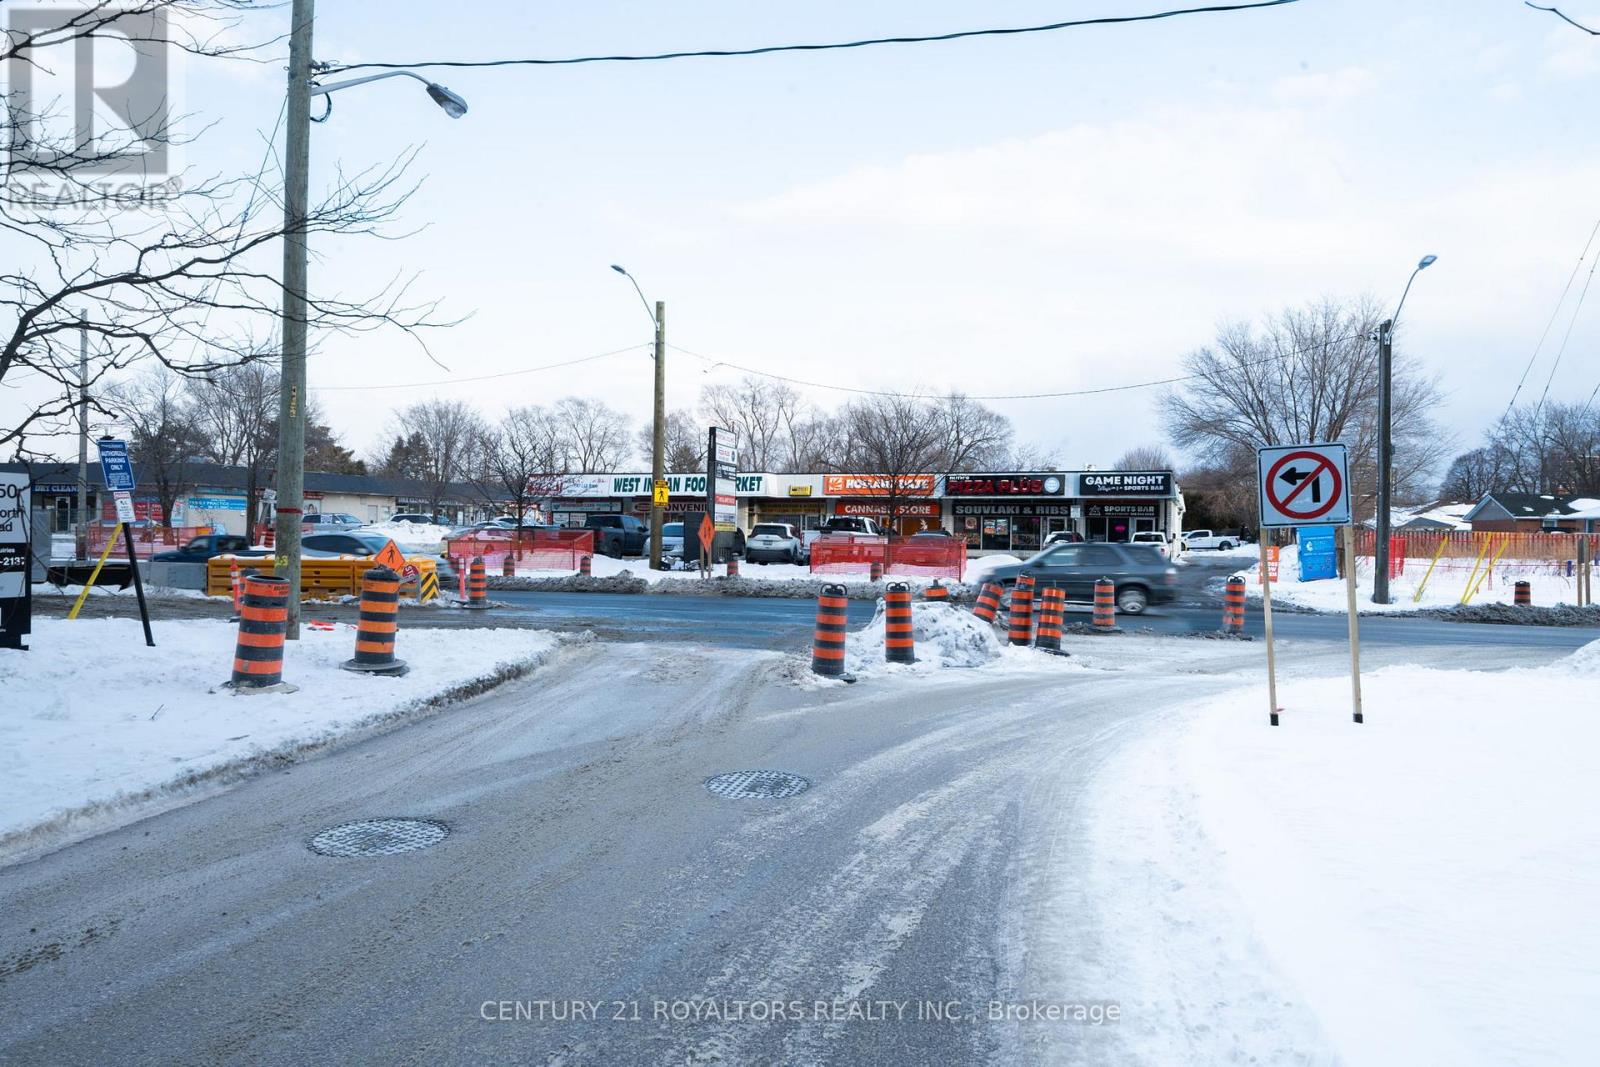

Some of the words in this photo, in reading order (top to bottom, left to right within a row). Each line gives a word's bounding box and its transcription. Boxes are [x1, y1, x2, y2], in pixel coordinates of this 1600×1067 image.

[613, 477, 640, 492] WEST
[643, 477, 683, 492] INAN
[684, 477, 709, 492] FOO
[734, 476, 763, 492] RKET
[1085, 476, 1121, 485] GAME
[1124, 475, 1165, 485] NIGHT
[899, 505, 931, 514] STORE
[955, 504, 1020, 515] SOUVLAKI
[1022, 505, 1033, 514] &
[1036, 505, 1069, 515] RIBS
